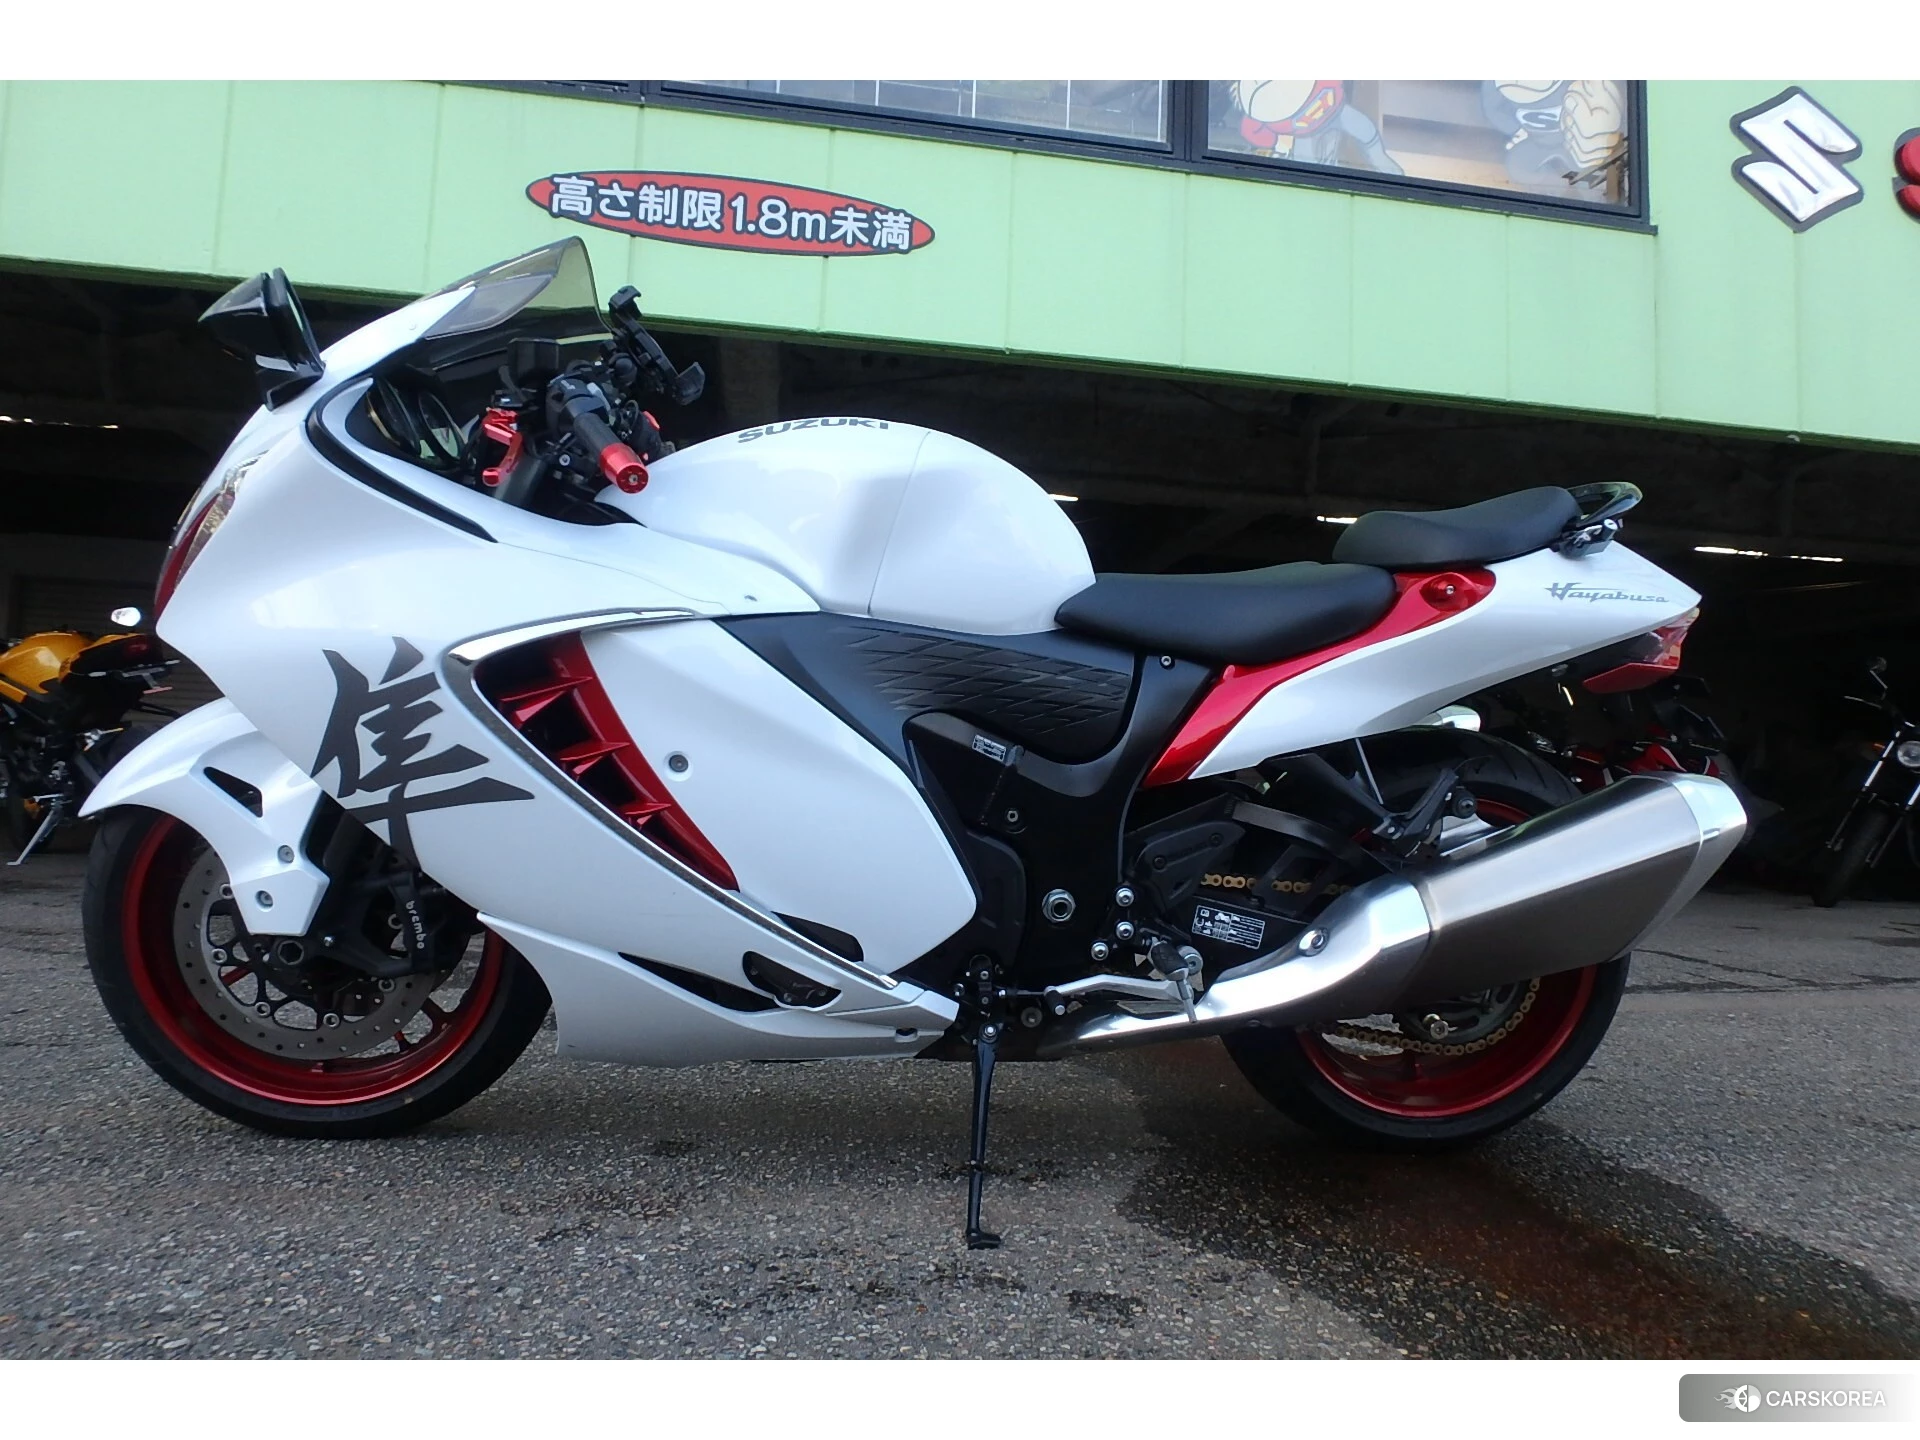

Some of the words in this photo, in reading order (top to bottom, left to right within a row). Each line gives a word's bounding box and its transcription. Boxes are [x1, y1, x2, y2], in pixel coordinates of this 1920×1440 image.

[550, 175, 912, 250] 高さ制限1.8m未満
[737, 418, 889, 443] SUZUKI
[1545, 582, 1670, 602] Hayabusa
[309, 635, 536, 870] 隼
[406, 900, 427, 950] brembo
